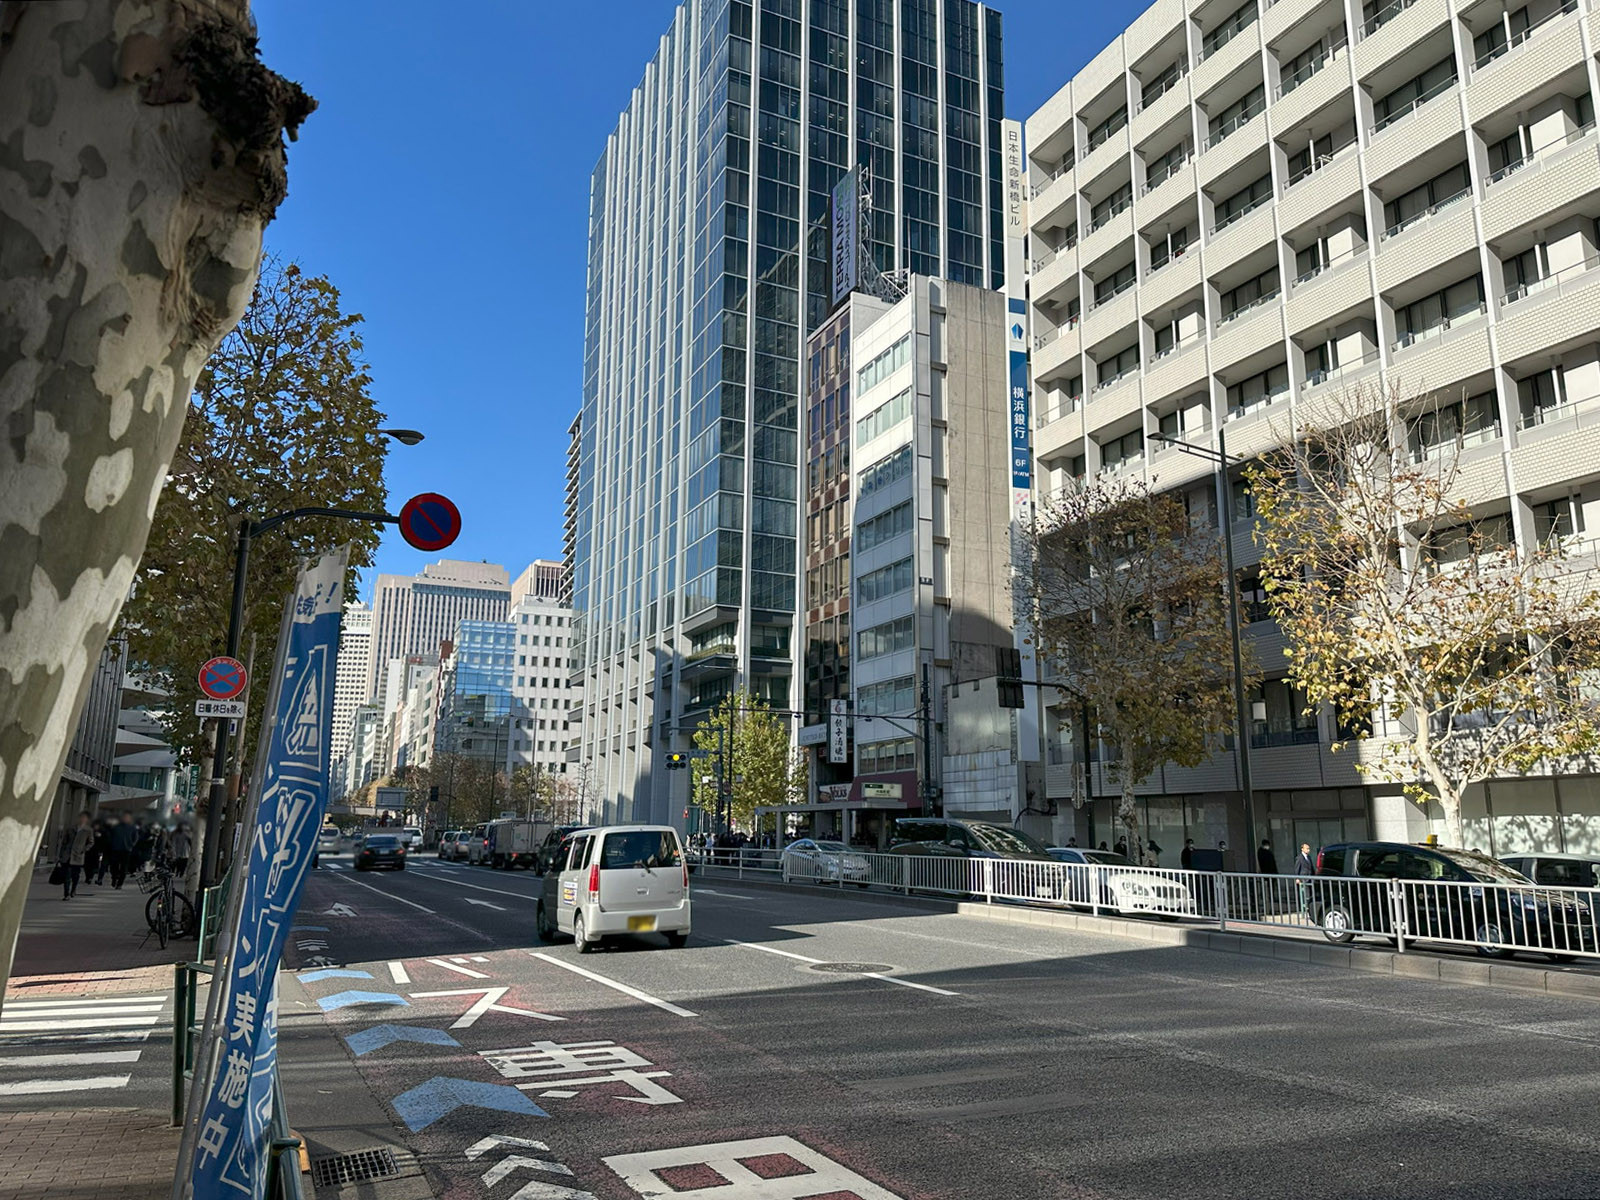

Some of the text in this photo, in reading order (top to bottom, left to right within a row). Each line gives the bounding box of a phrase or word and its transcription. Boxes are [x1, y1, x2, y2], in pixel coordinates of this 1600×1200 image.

[1008, 130, 1020, 226] 日本生命新橋ビル
[836, 237, 844, 299] TERRA
[1013, 386, 1026, 439] 横浜銀行
[1015, 458, 1026, 467] 6F
